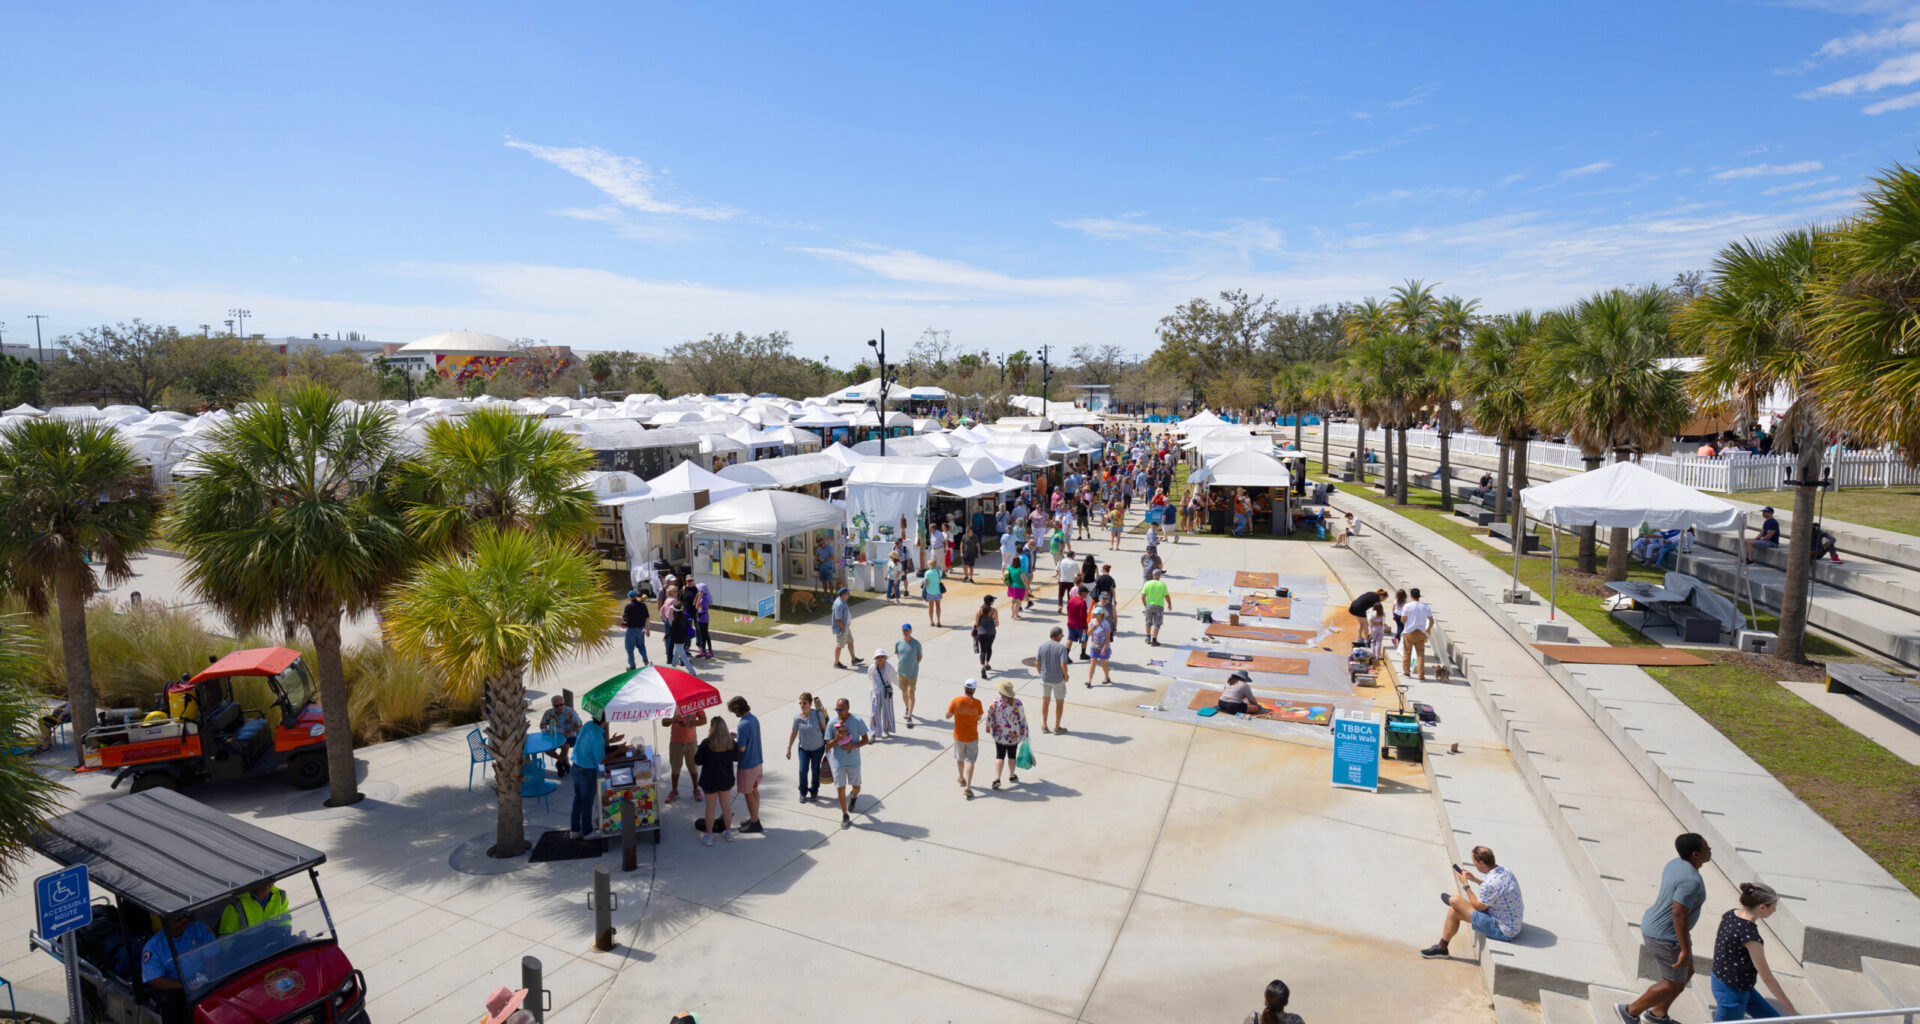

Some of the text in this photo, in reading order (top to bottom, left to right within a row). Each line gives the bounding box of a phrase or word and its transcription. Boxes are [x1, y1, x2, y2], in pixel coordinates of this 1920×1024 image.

[681, 695, 719, 715] ITALIAN ICE
[611, 709, 651, 721] ITALIAN
[654, 707, 672, 718] ICE
[1342, 724, 1373, 735] TBBCA
[1336, 732, 1377, 743] Chalk Walk
[43, 896, 88, 920] ACCESSIBLE
[54, 908, 79, 922] ROUTE
